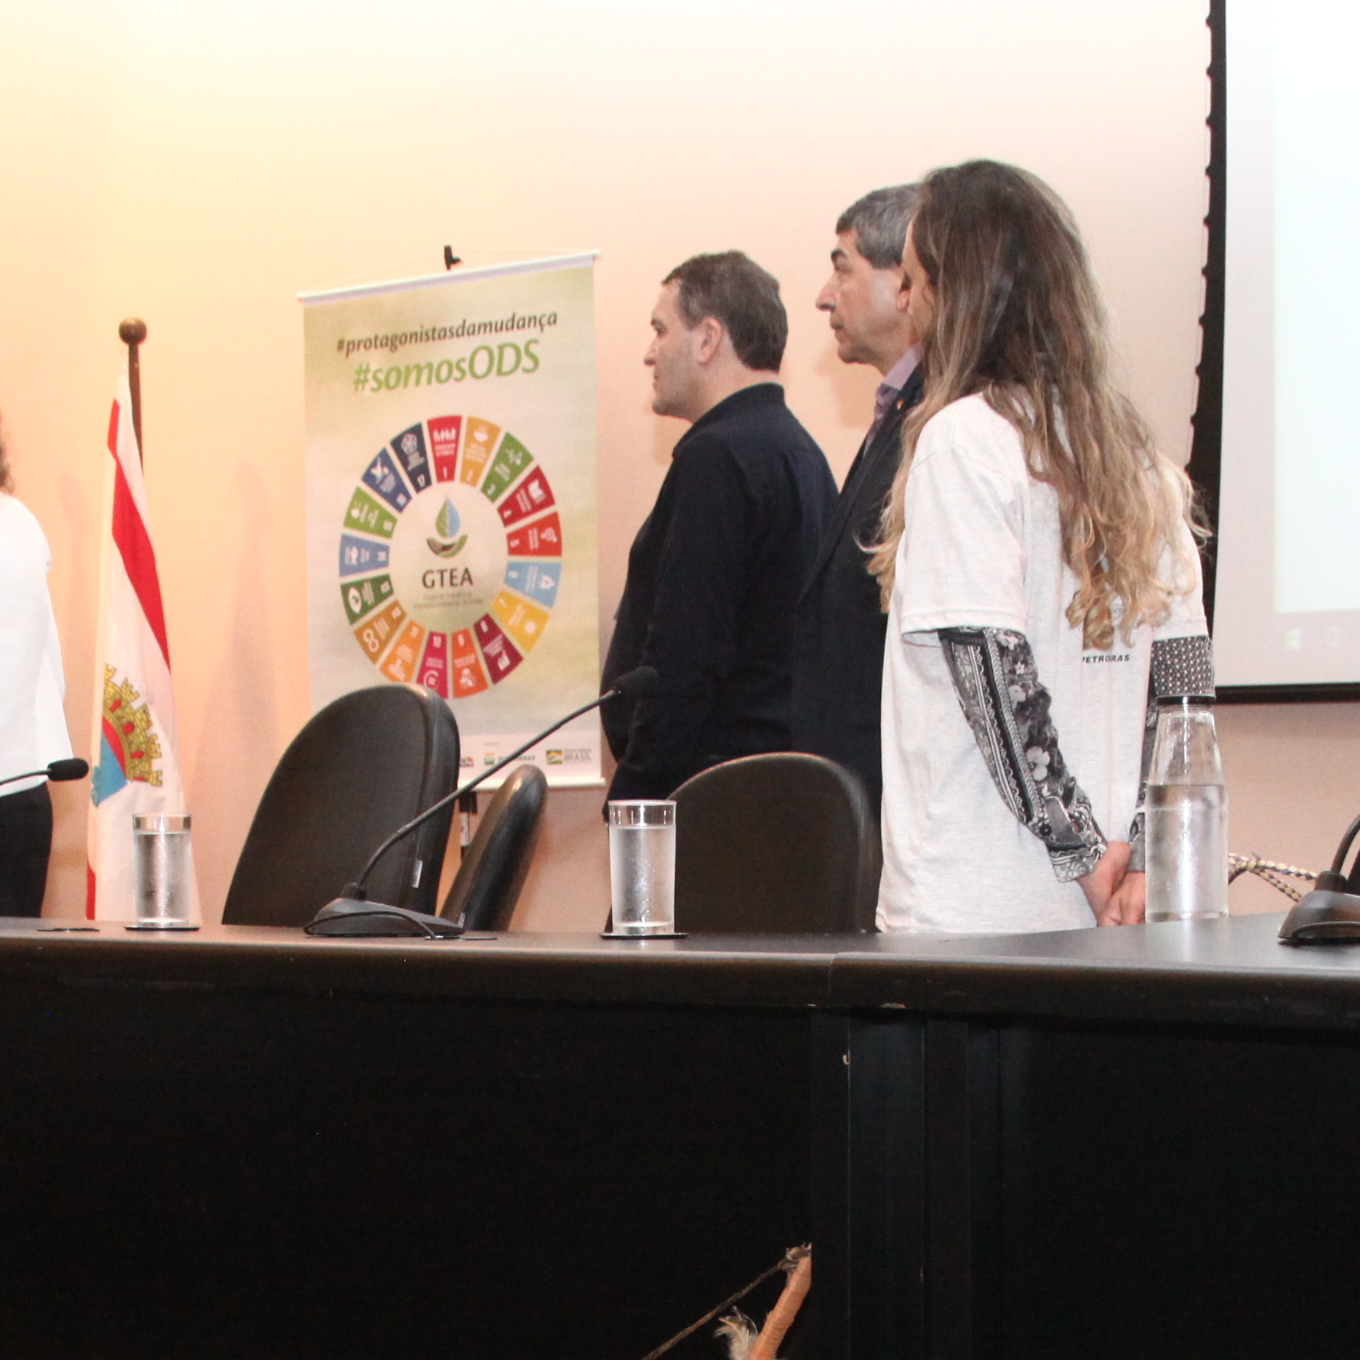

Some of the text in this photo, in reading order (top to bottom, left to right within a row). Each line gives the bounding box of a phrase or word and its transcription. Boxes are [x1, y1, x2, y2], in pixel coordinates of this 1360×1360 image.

[337, 312, 558, 358] #protagonistasdamudança
[353, 338, 540, 392] #somosODS
[422, 567, 473, 589] GTEA
